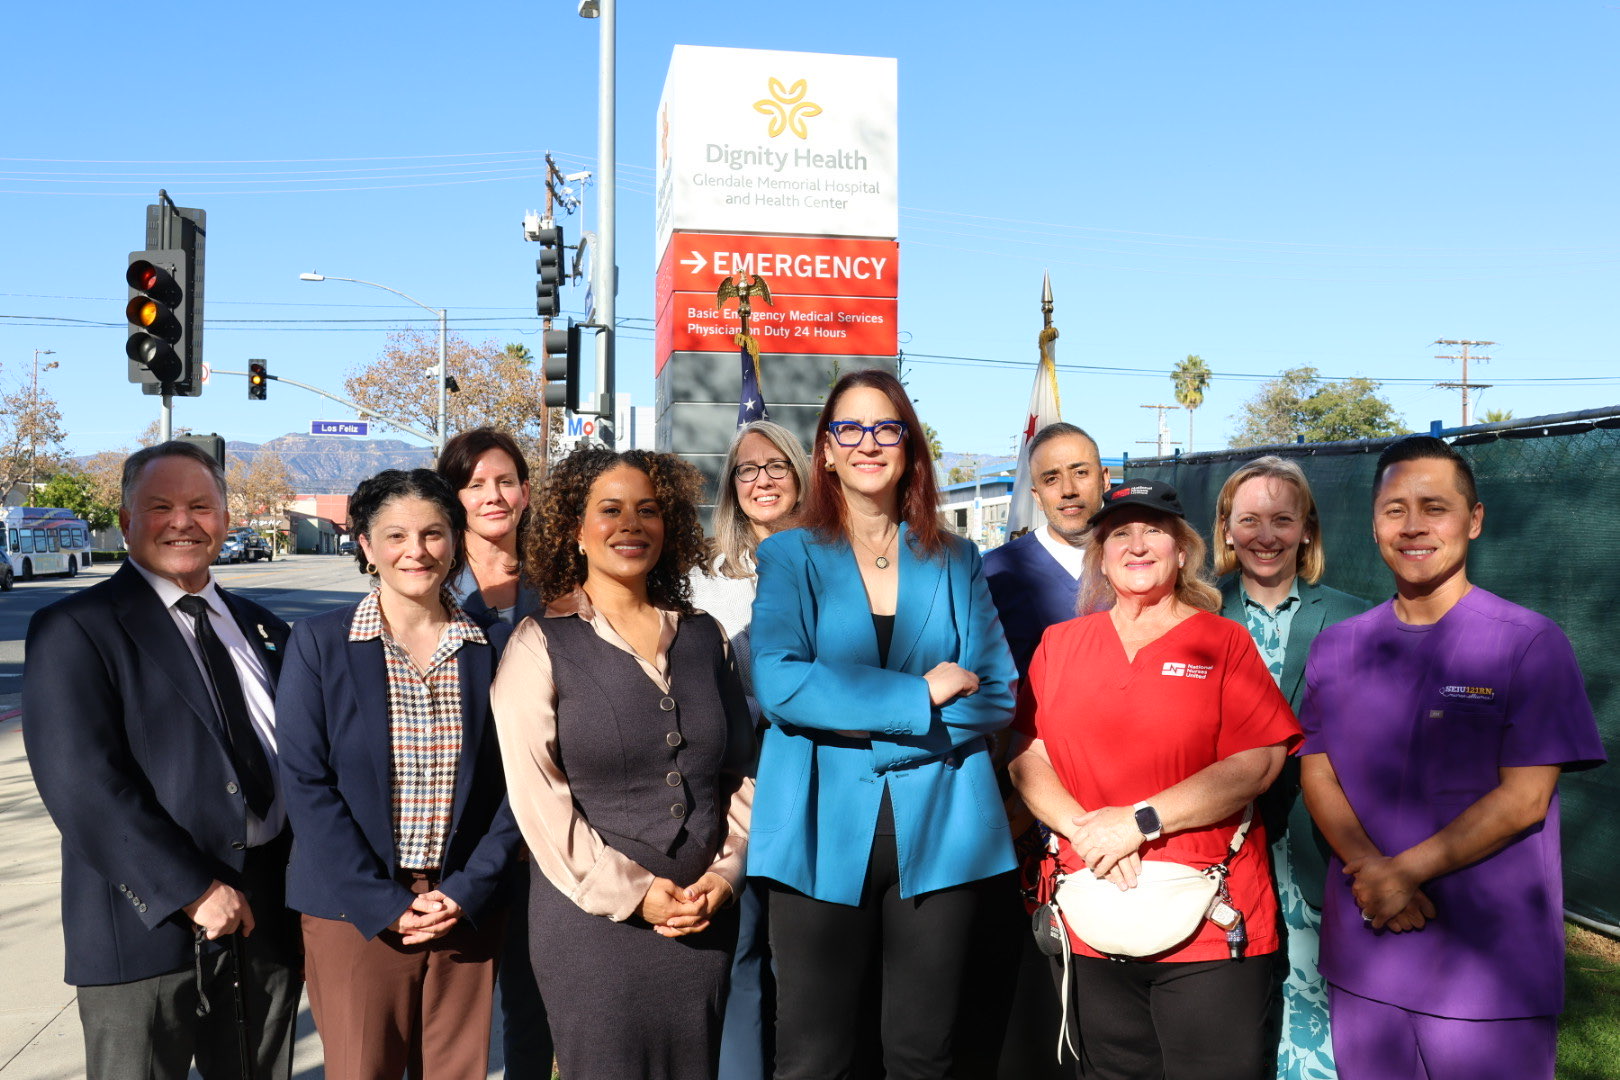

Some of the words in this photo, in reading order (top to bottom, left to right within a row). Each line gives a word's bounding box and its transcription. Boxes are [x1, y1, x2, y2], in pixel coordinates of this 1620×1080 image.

[706, 143, 788, 172] Dignity
[794, 148, 867, 171] Health
[693, 173, 753, 188] Glendale
[757, 176, 821, 191] Memorial
[825, 179, 880, 196] Hospital
[725, 192, 750, 205] and
[755, 193, 800, 207] Health
[804, 195, 848, 209] Center
[713, 251, 887, 280] EMERGENCY
[687, 307, 719, 319] Basic
[789, 310, 834, 322] Medical
[837, 312, 884, 324] Services
[687, 323, 742, 337] Physician
[764, 325, 790, 339] Duty
[794, 326, 810, 337] 24
[814, 327, 847, 338] Hours
[321, 423, 337, 432] Los
[339, 424, 359, 433] Feliz
